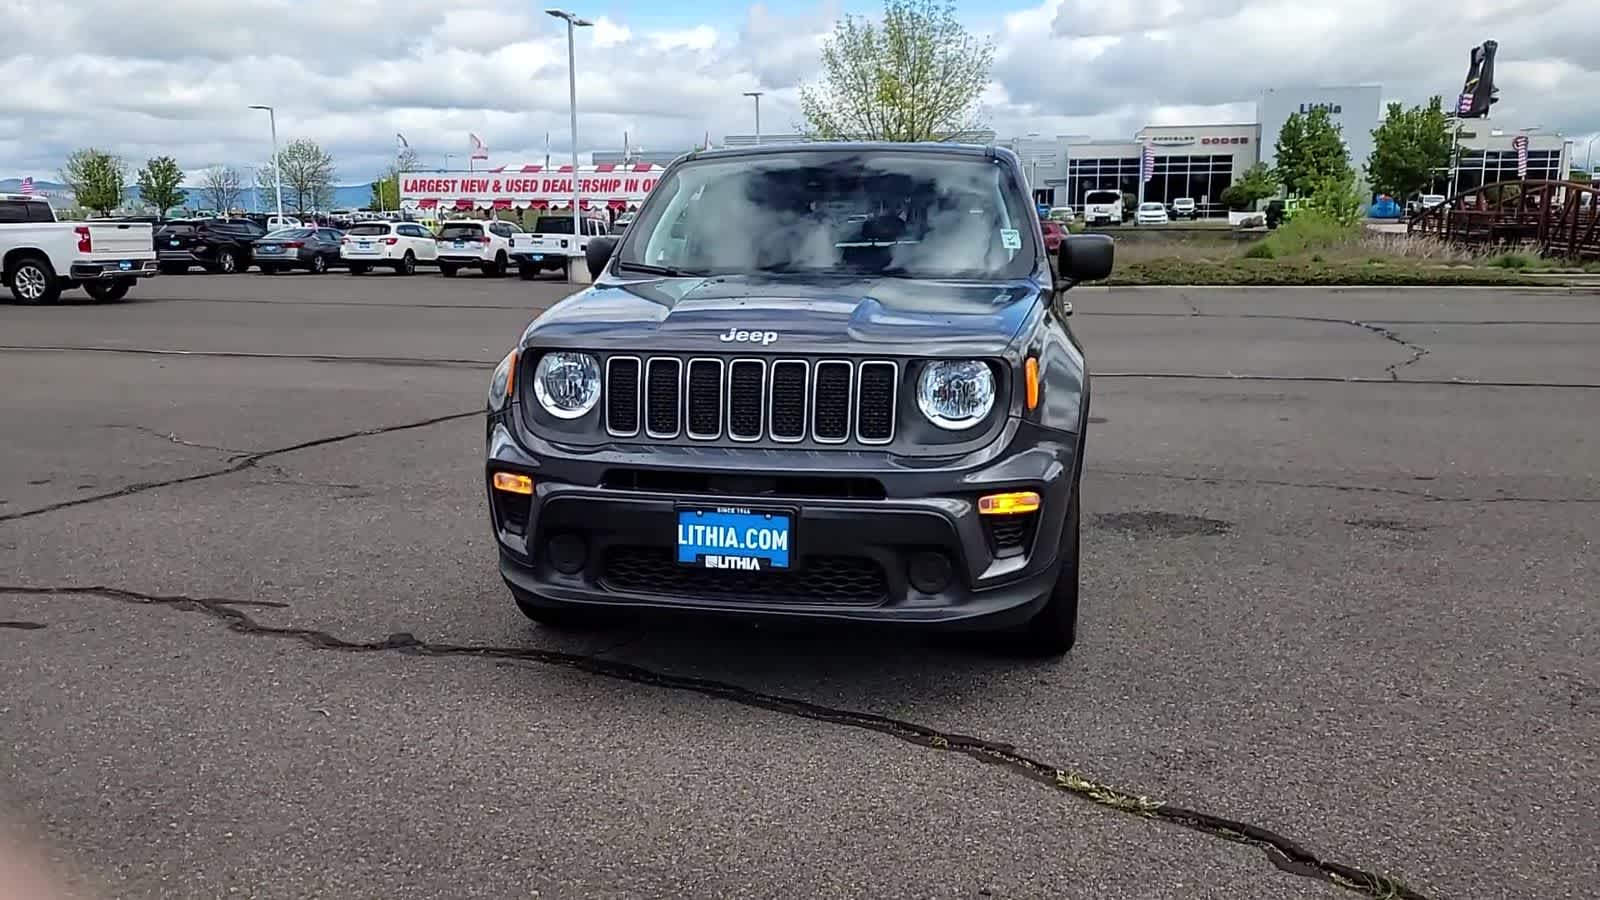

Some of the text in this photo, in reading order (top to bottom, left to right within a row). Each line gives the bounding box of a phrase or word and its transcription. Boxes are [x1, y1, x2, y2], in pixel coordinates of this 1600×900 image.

[1202, 137, 1249, 145] DODGE
[403, 179, 458, 193] LARGEST
[460, 179, 490, 193] NEW
[493, 180, 502, 193] &
[506, 179, 538, 193] USED
[624, 179, 639, 193] IN
[719, 327, 778, 345] Jeep
[678, 524, 788, 551] LITHIA.COM
[718, 555, 761, 571] LITHIA
